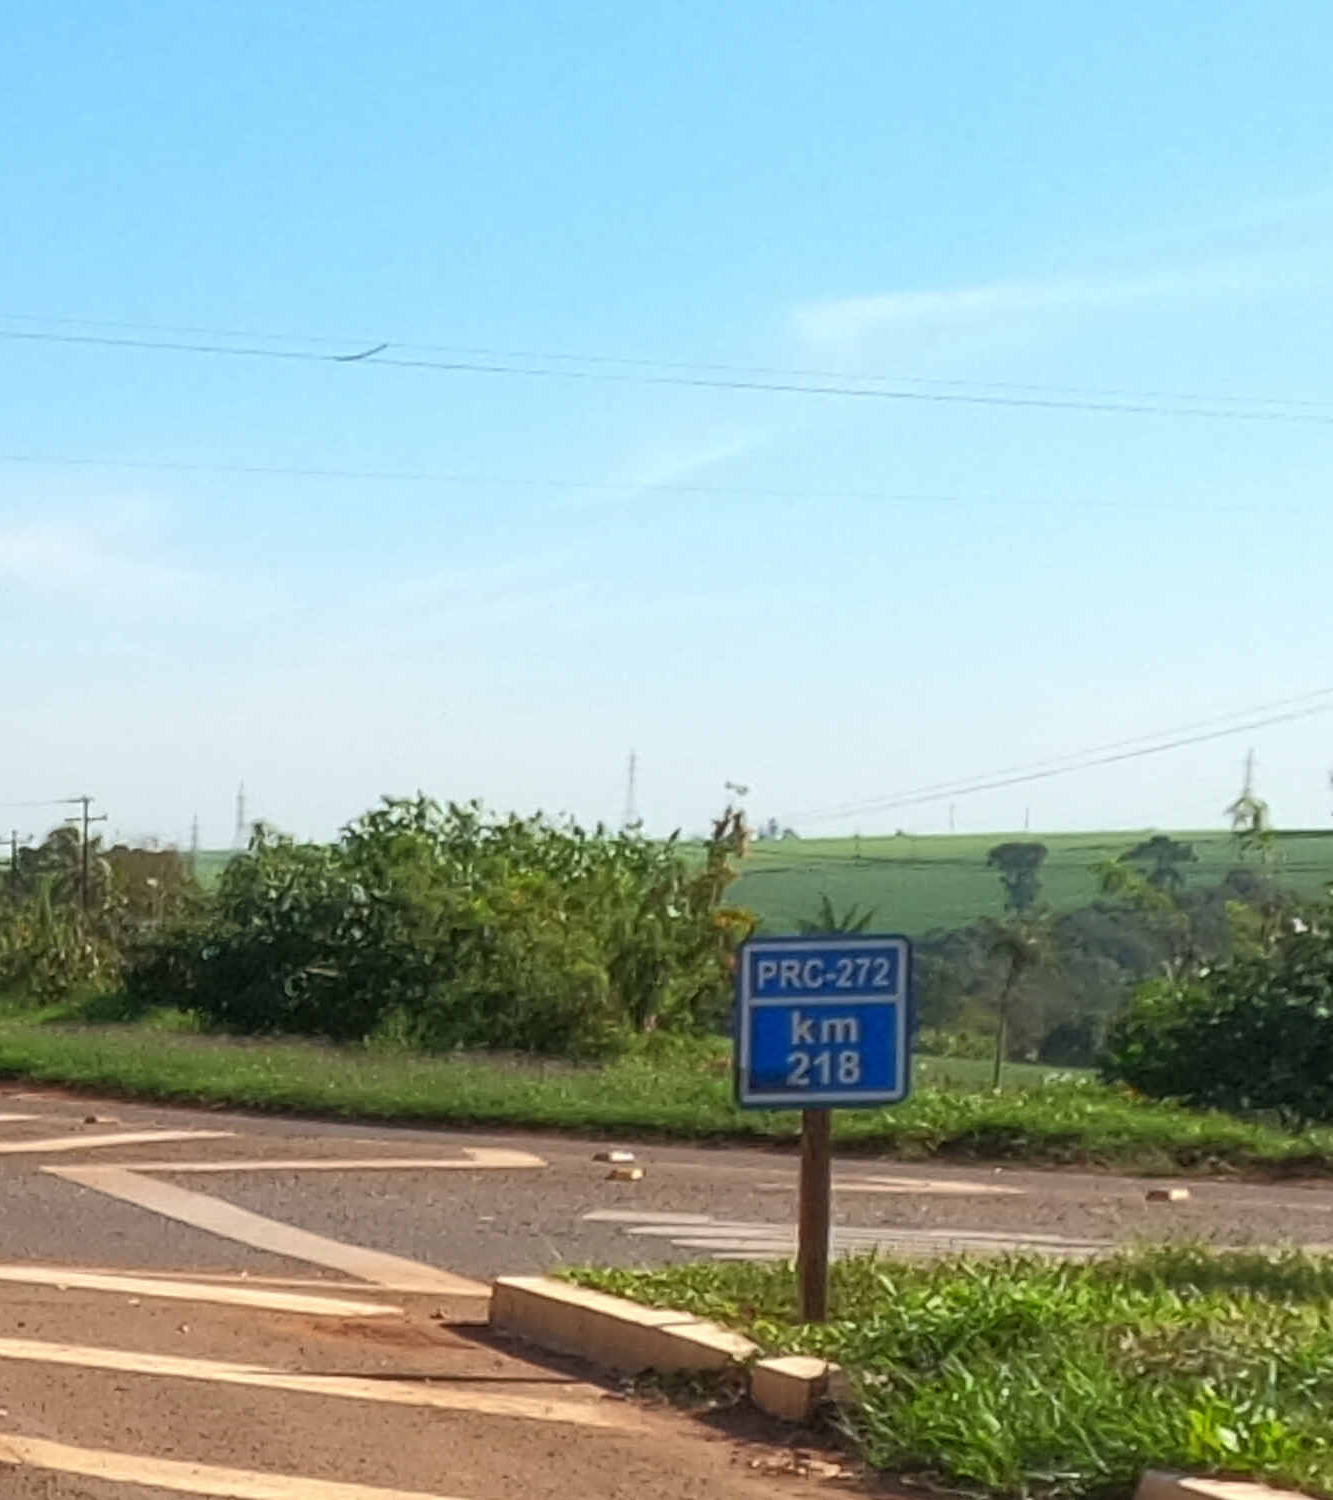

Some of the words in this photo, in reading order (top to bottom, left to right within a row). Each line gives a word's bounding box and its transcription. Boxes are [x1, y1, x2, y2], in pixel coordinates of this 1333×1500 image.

[756, 957, 891, 989] PRC-272
[790, 1010, 860, 1045] km
[785, 1050, 862, 1086] 218
